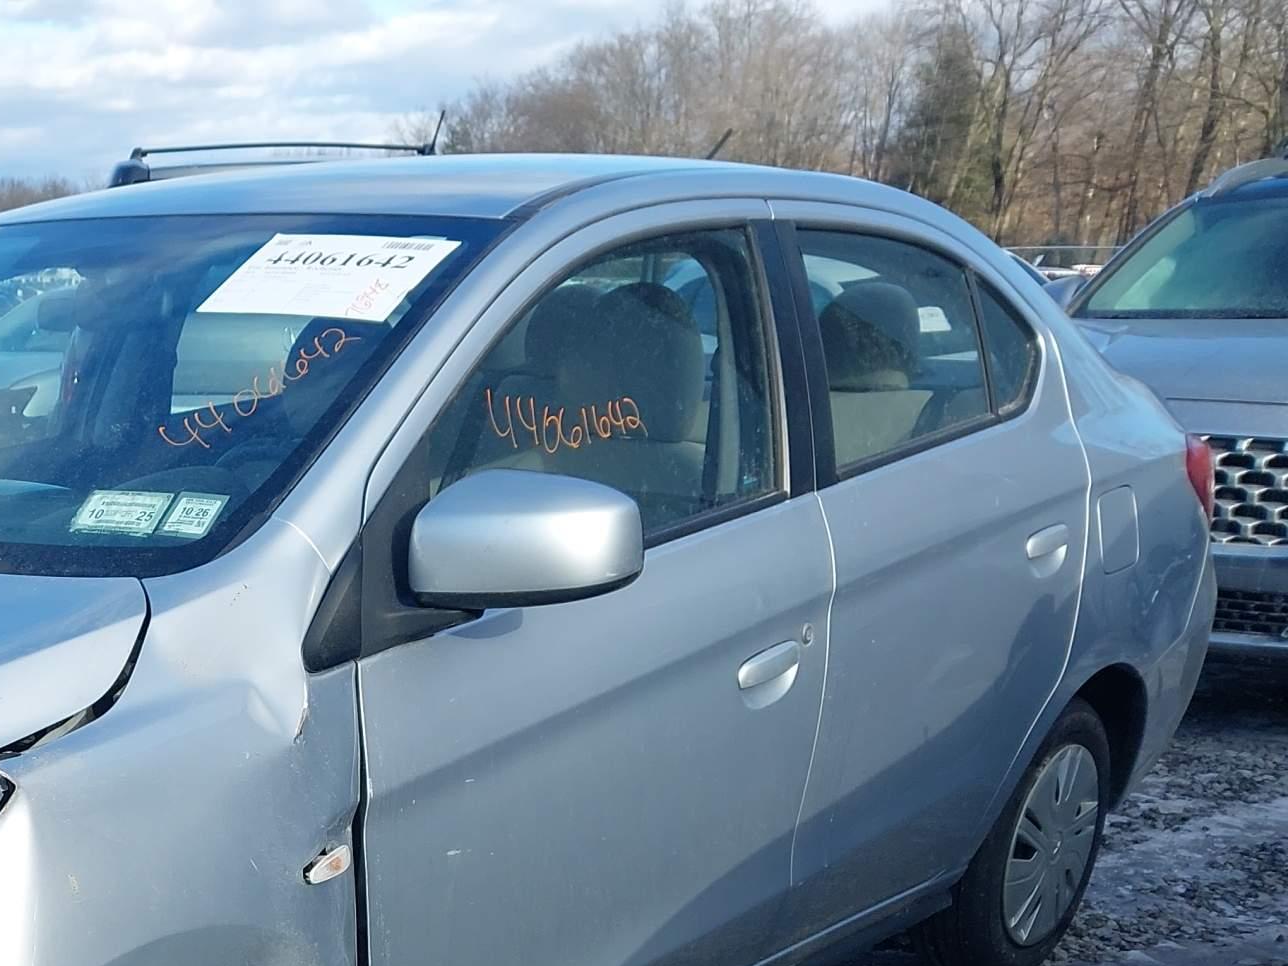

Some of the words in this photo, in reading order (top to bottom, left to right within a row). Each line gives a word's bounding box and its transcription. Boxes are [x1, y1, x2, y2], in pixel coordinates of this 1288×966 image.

[266, 250, 415, 269] 44061642
[159, 328, 361, 448] 44061642
[485, 388, 649, 453] 44061642
[88, 508, 105, 519] 10
[135, 511, 155, 522] 25
